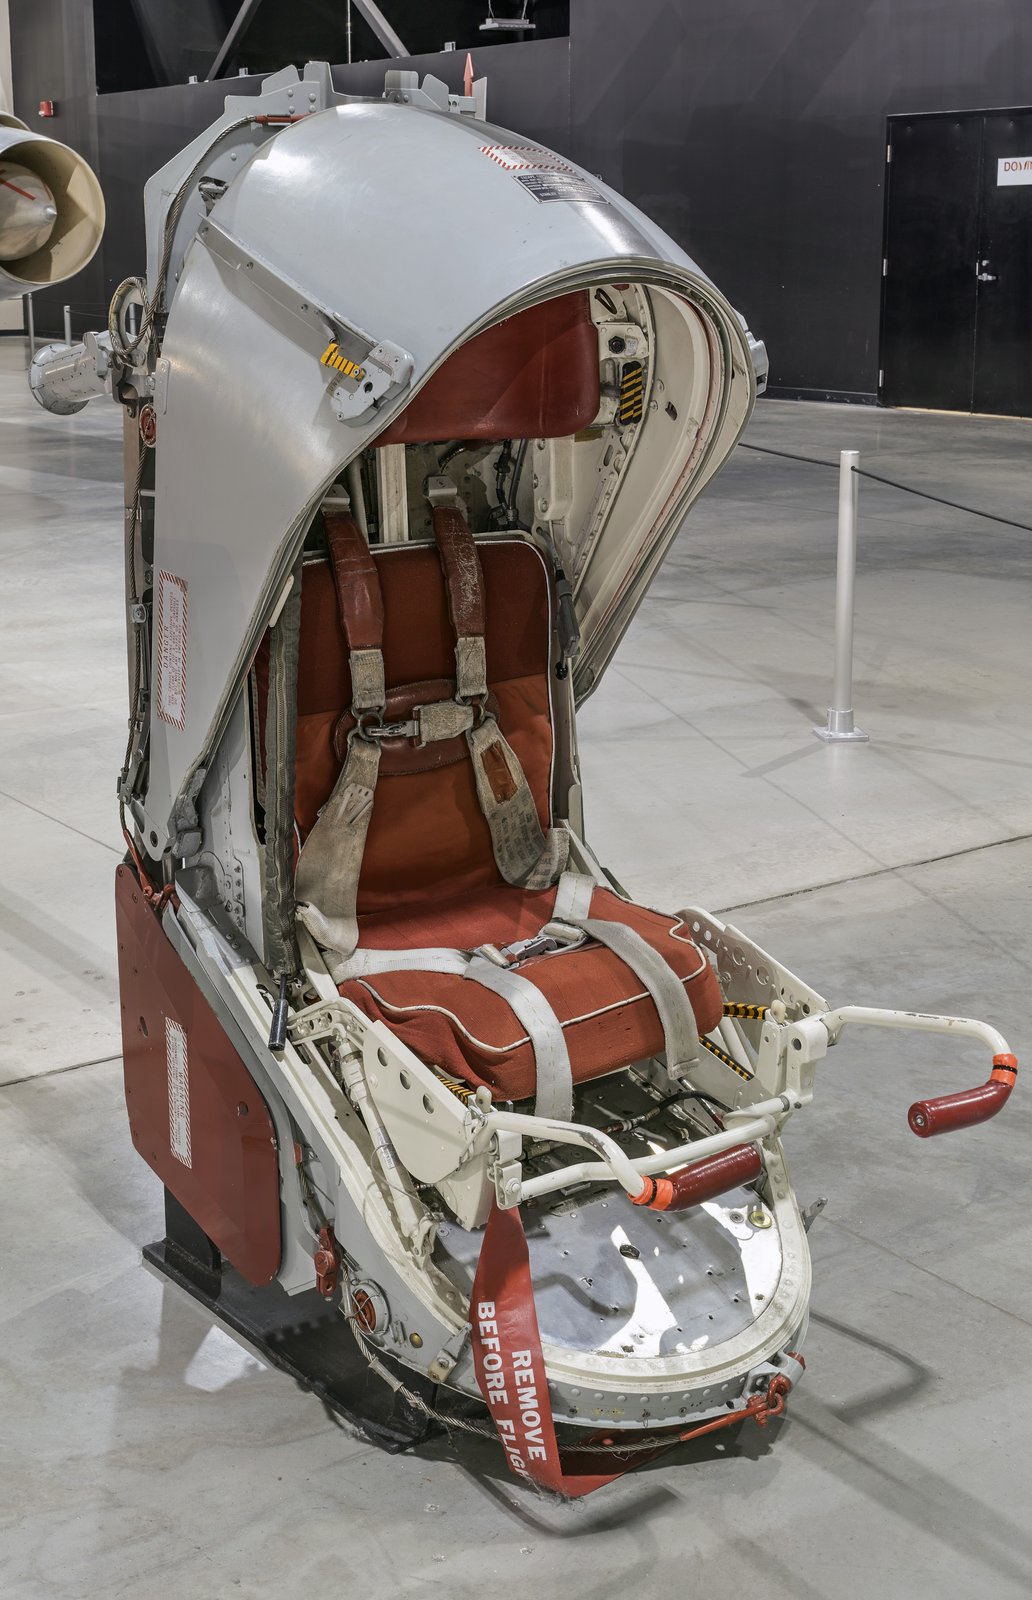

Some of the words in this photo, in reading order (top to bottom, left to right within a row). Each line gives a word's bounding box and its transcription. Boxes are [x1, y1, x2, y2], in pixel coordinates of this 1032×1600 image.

[477, 1301, 509, 1405] BEFORE
[496, 1419, 529, 1476] FLIGH
[511, 1349, 547, 1461] REMOVE
